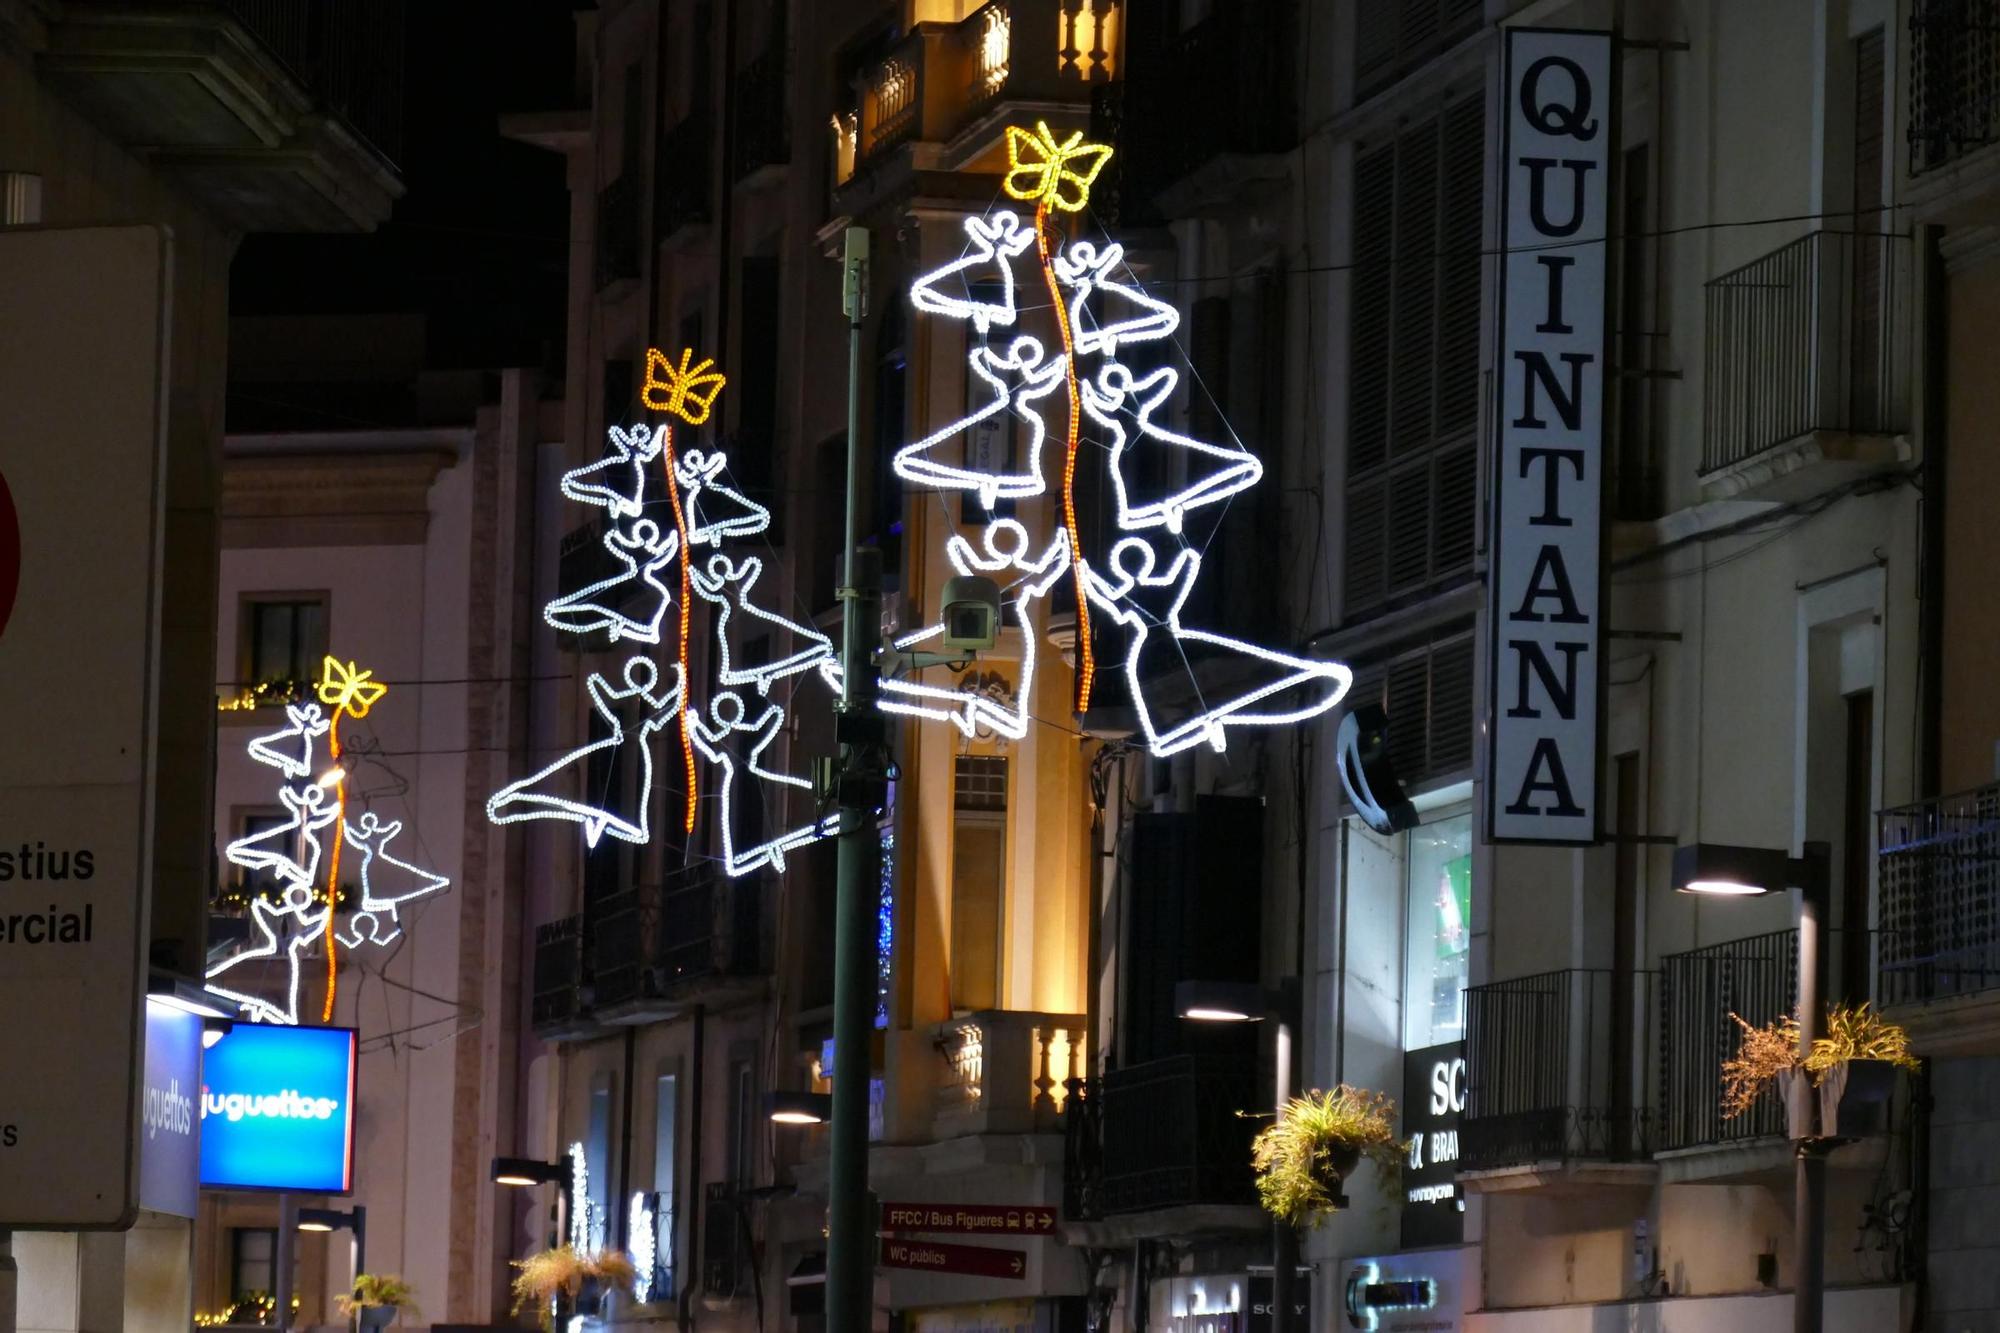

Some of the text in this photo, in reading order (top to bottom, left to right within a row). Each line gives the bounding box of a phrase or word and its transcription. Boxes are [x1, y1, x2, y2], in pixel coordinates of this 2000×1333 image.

[1505, 56, 1598, 817] QUINTANA
[0, 904, 93, 944] rcial
[201, 1085, 333, 1121] juguettos
[891, 1211, 922, 1225] FFCC
[931, 1211, 953, 1226] Bus
[956, 1212, 1004, 1230] Figueres
[890, 1247, 908, 1261] WC
